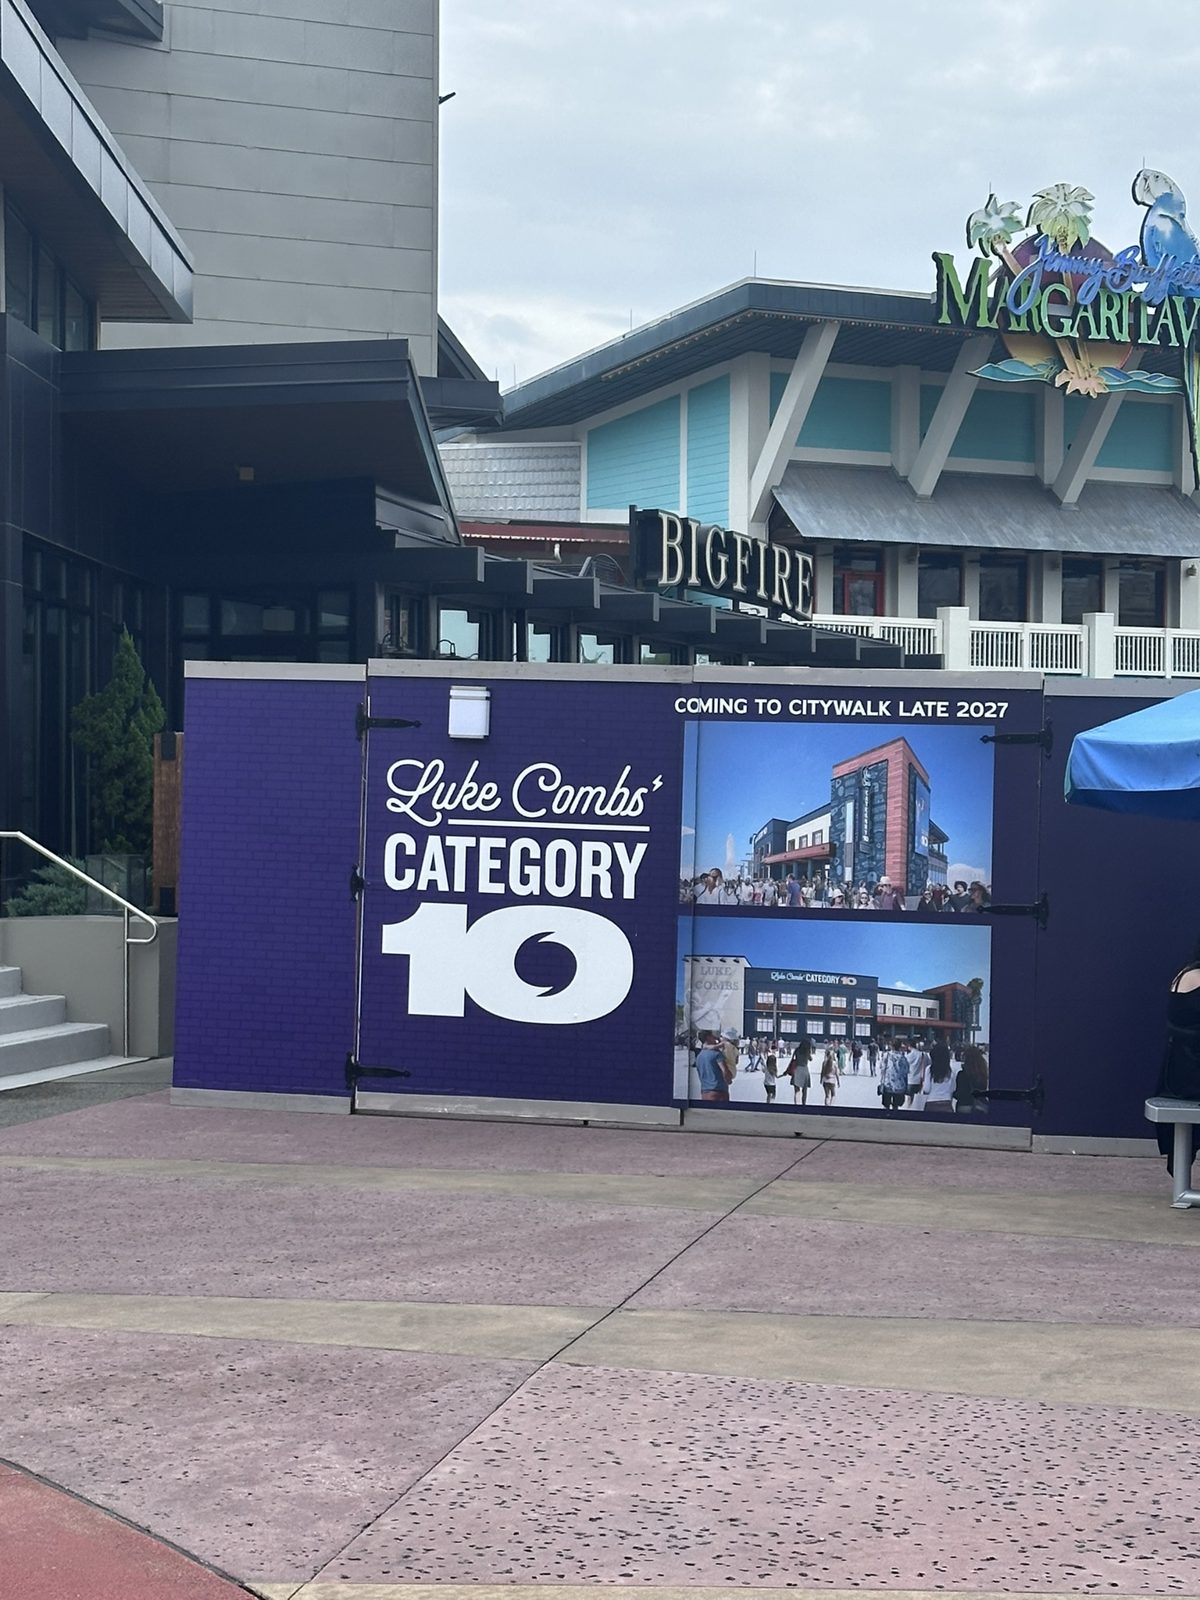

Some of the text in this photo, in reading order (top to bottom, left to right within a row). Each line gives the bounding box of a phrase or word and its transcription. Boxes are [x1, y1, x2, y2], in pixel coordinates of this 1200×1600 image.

[1006, 233, 1106, 316] Jimmy
[674, 697, 1009, 718] COMING TO CITYWALK LATE 2027
[386, 758, 502, 828] Luke
[384, 832, 649, 900] CATEGORY
[381, 902, 634, 1025] 10
[695, 980, 739, 991] COMBS
[700, 966, 732, 976] LUKE
[805, 973, 840, 985] CATEGORY
[840, 976, 857, 986] 10
